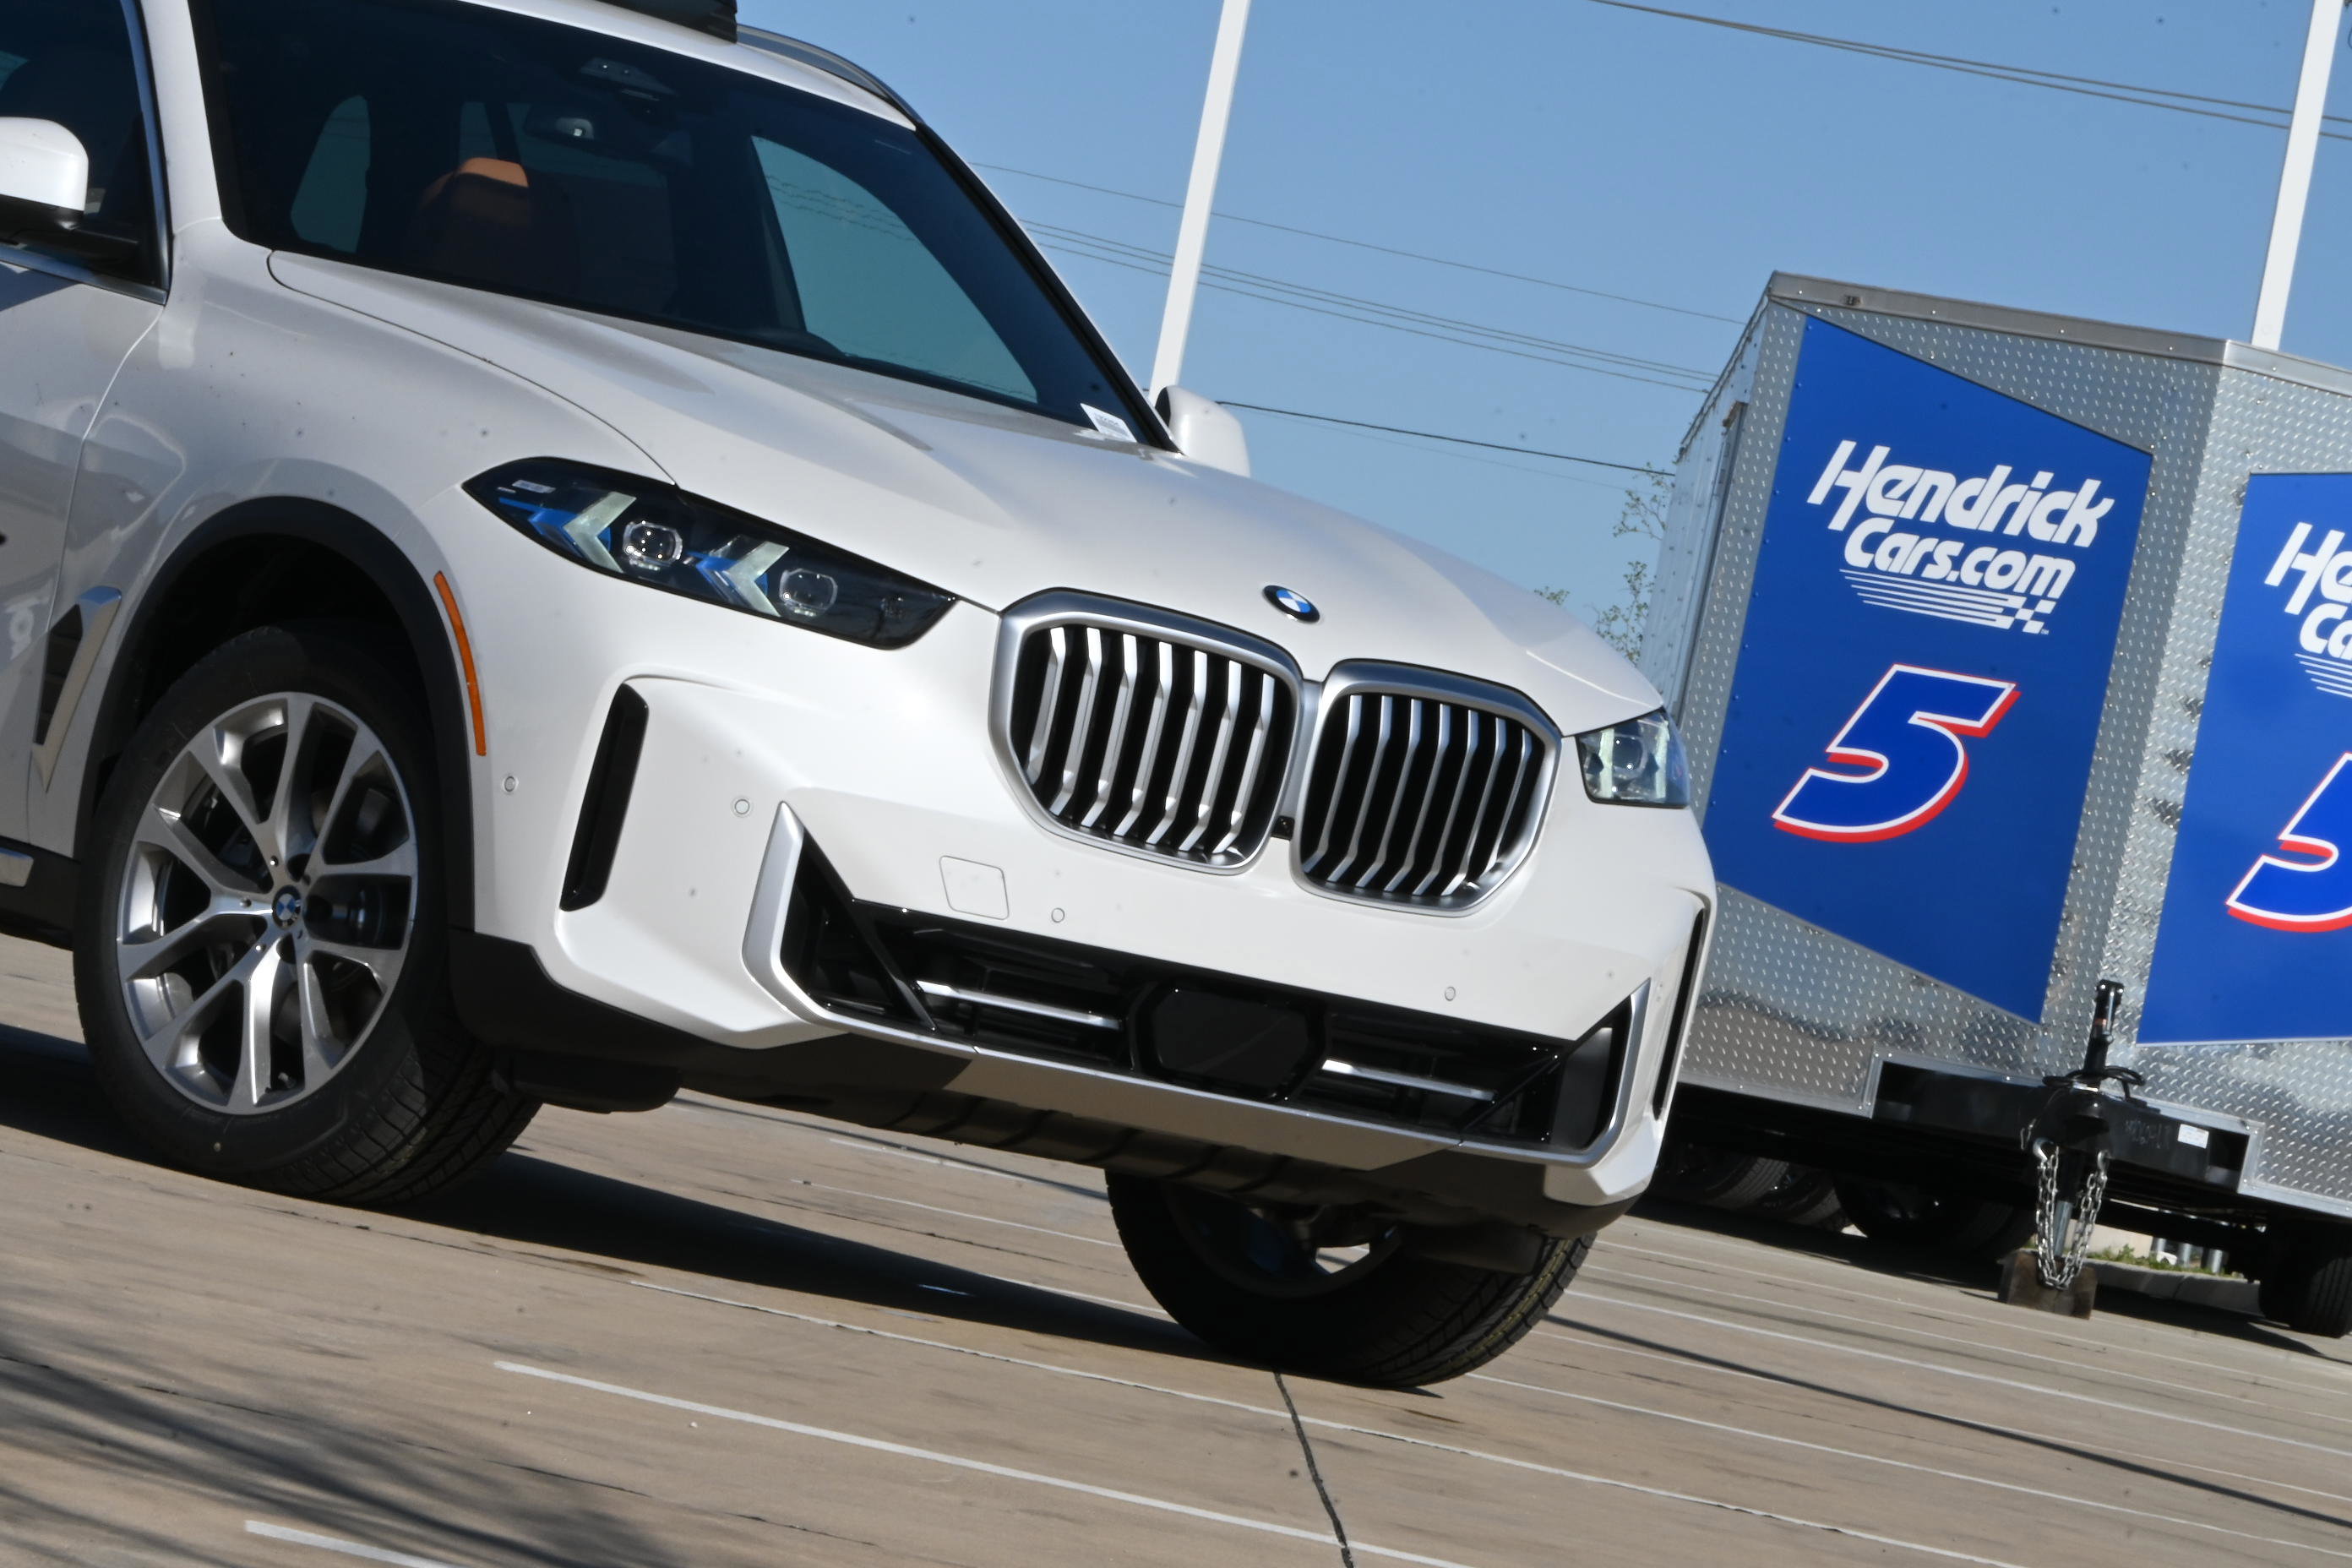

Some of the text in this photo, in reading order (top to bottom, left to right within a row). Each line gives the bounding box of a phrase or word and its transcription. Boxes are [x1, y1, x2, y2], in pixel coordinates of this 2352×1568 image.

[1806, 439, 2115, 547] Hendrick
[1844, 517, 2076, 599] Cars.com
[1772, 663, 2022, 843] 5
